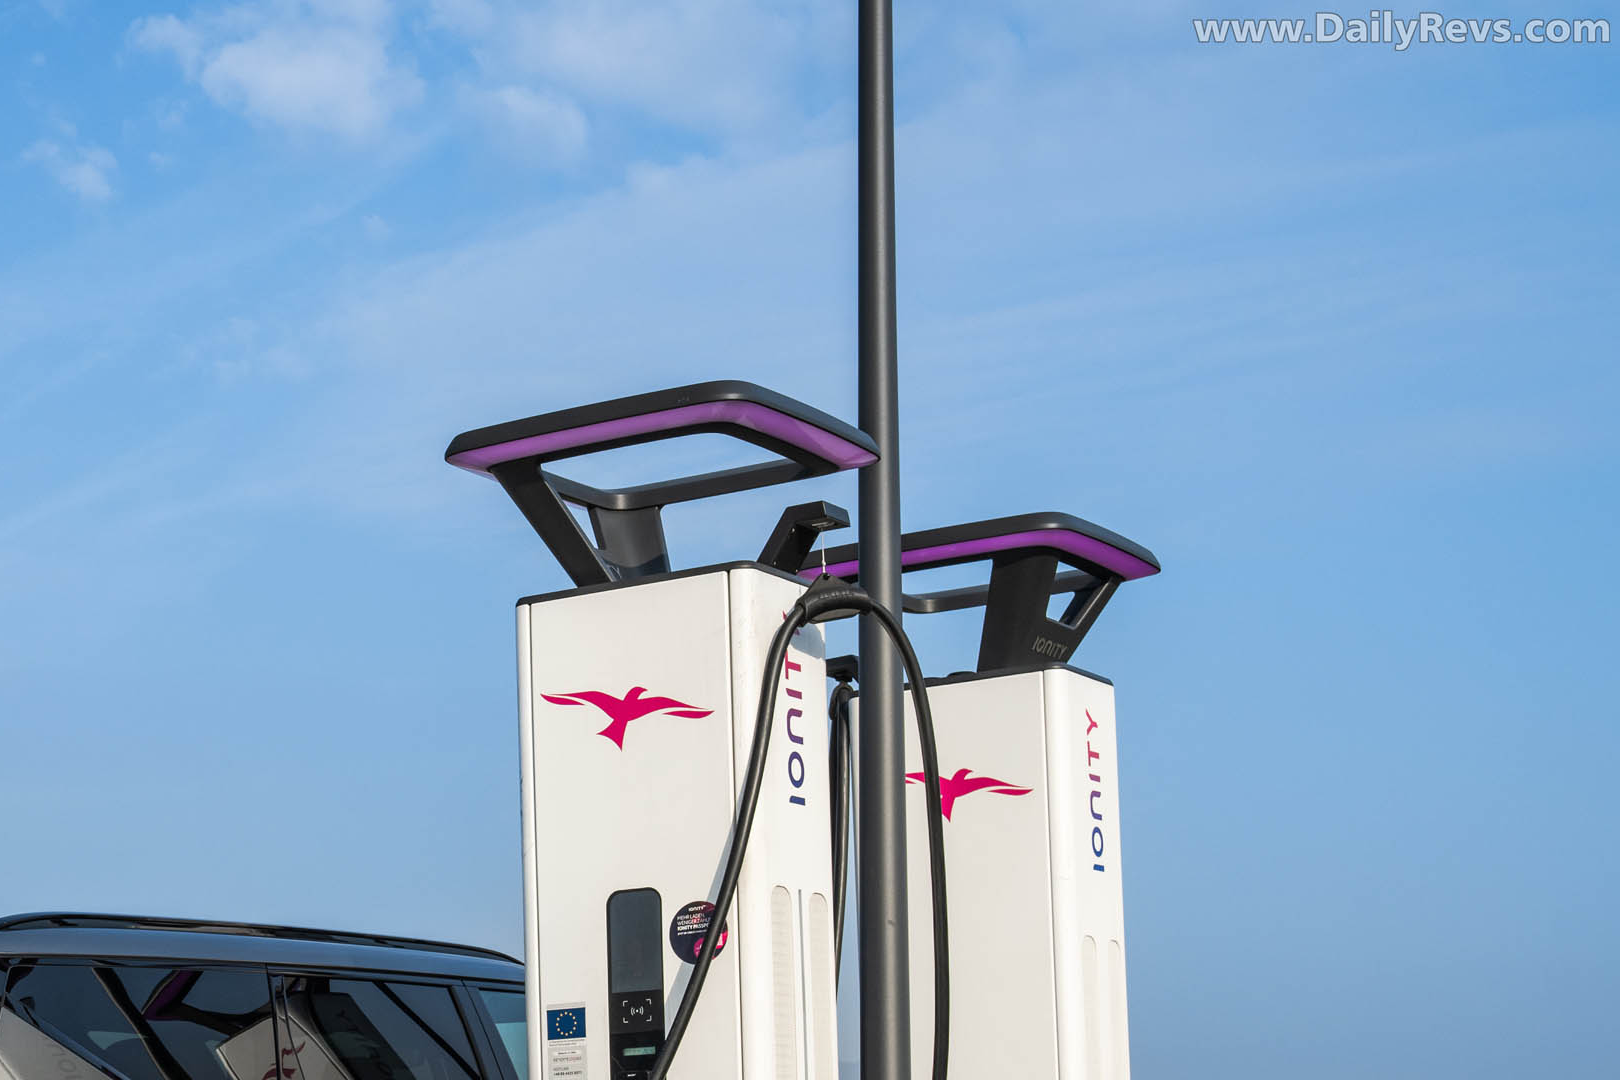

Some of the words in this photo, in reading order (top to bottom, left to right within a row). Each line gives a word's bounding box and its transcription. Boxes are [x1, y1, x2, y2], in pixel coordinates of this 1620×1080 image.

[783, 611, 806, 805] IONIT
[1032, 636, 1068, 659] IONITY
[1085, 708, 1105, 872] IONITY
